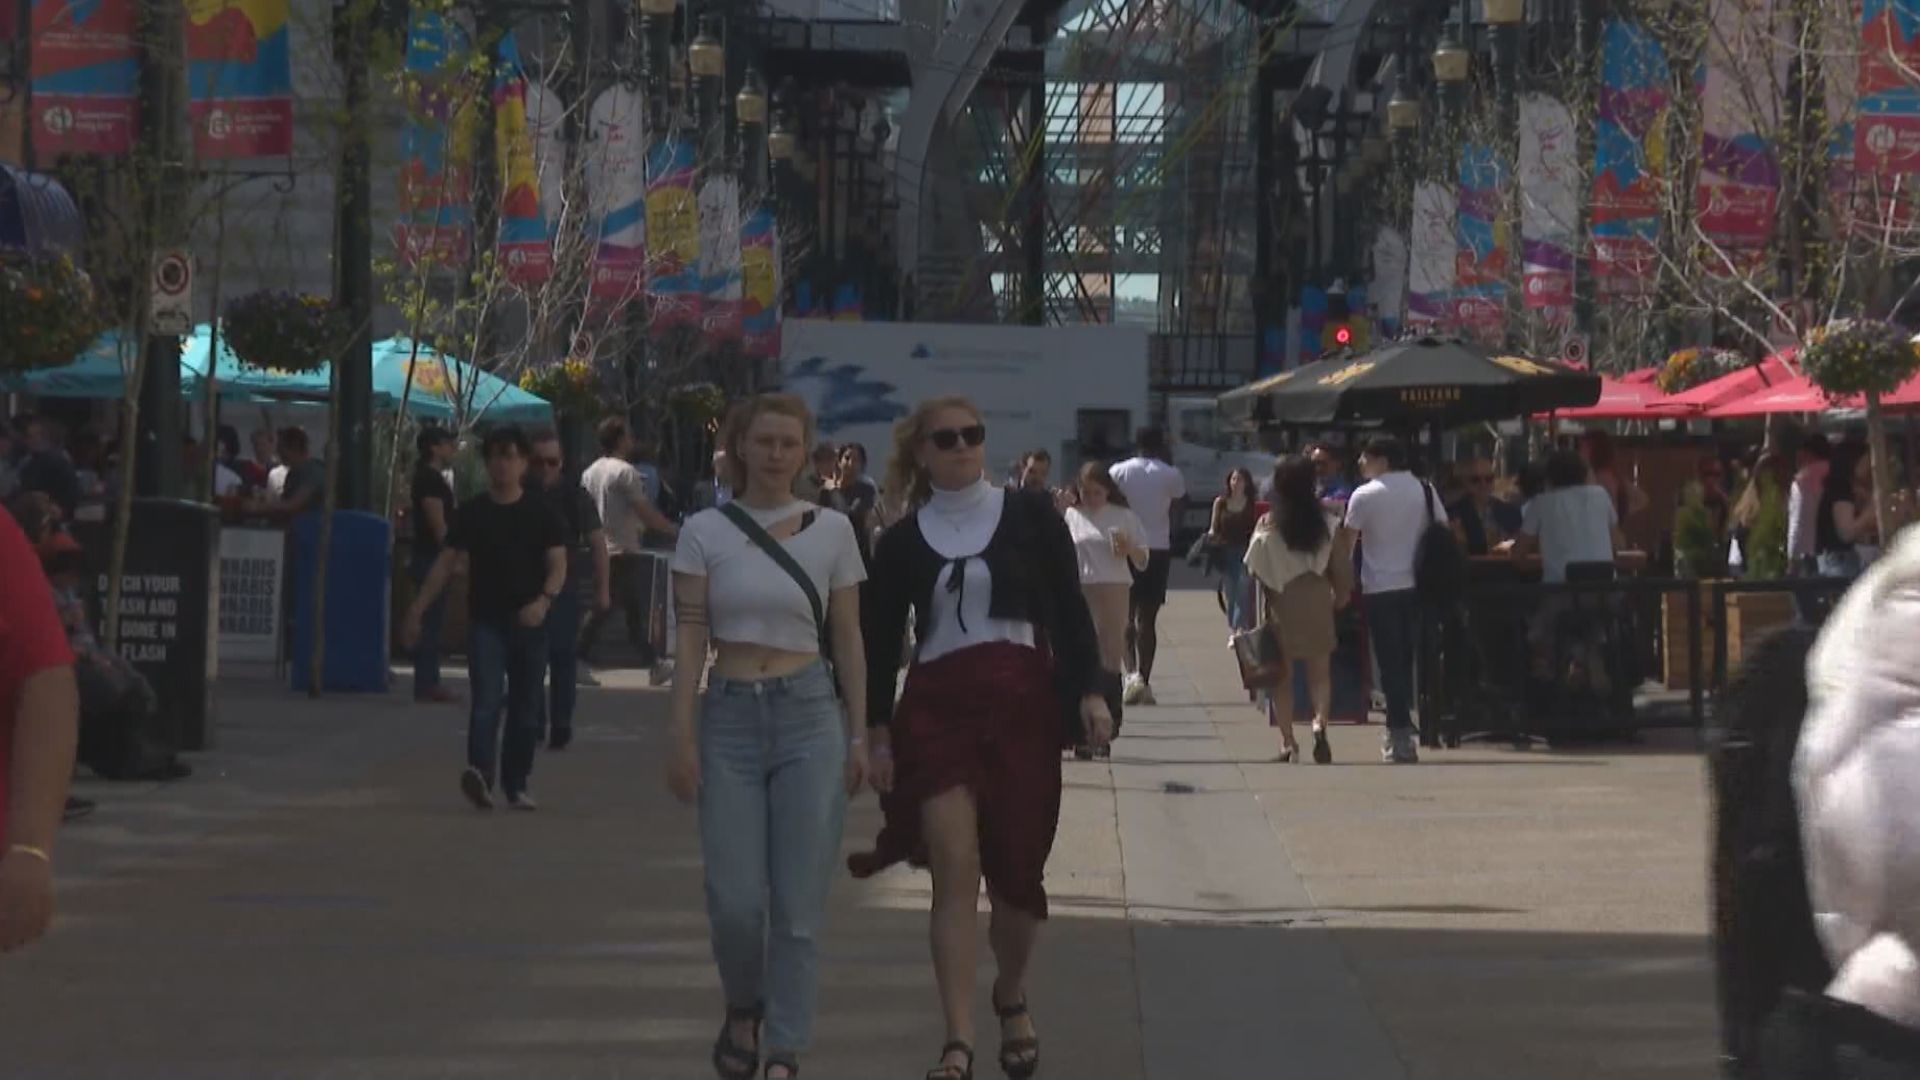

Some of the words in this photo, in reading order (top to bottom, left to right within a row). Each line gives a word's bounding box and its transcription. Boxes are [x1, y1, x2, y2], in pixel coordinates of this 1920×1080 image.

[98, 575, 141, 592] DCH
[143, 575, 181, 592] YOUR
[100, 597, 145, 615] TASH
[148, 598, 177, 616] AND
[120, 620, 158, 638] DONE
[161, 621, 176, 639] IN
[120, 643, 167, 662] FLASH
